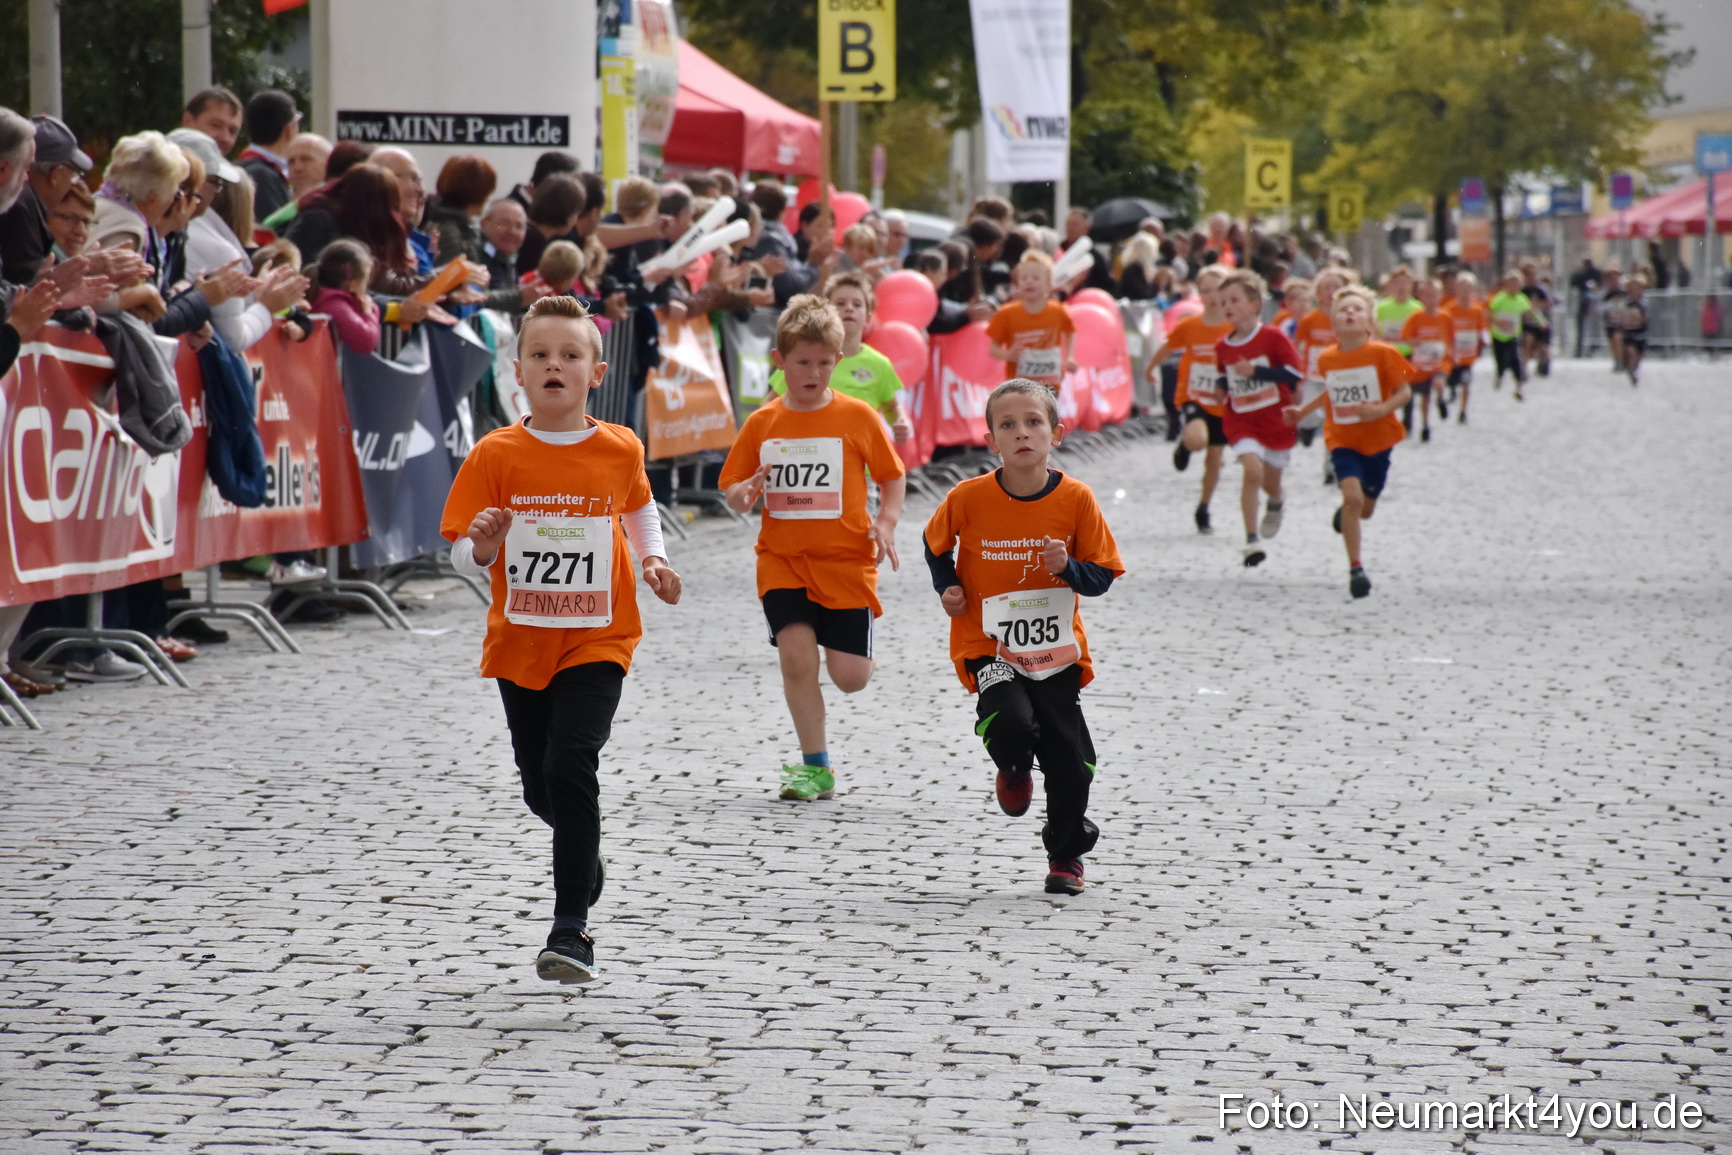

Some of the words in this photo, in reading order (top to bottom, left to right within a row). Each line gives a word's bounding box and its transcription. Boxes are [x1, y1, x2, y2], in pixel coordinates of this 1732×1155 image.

[840, 22, 874, 73] B
[338, 115, 562, 144] www.MINI-Partl.de
[1257, 161, 1278, 191] C
[1332, 384, 1369, 404] 7281
[772, 463, 830, 488] 7072
[511, 493, 585, 505] Neumarkter
[787, 496, 813, 505] Simon
[547, 528, 585, 537] BOCK
[981, 550, 1033, 562] Stadtlauf
[522, 551, 594, 584] 7271
[511, 592, 597, 615] LENNARD
[1018, 598, 1049, 608] BOCK
[998, 615, 1060, 647] 7035
[1017, 653, 1054, 667] Raphael
